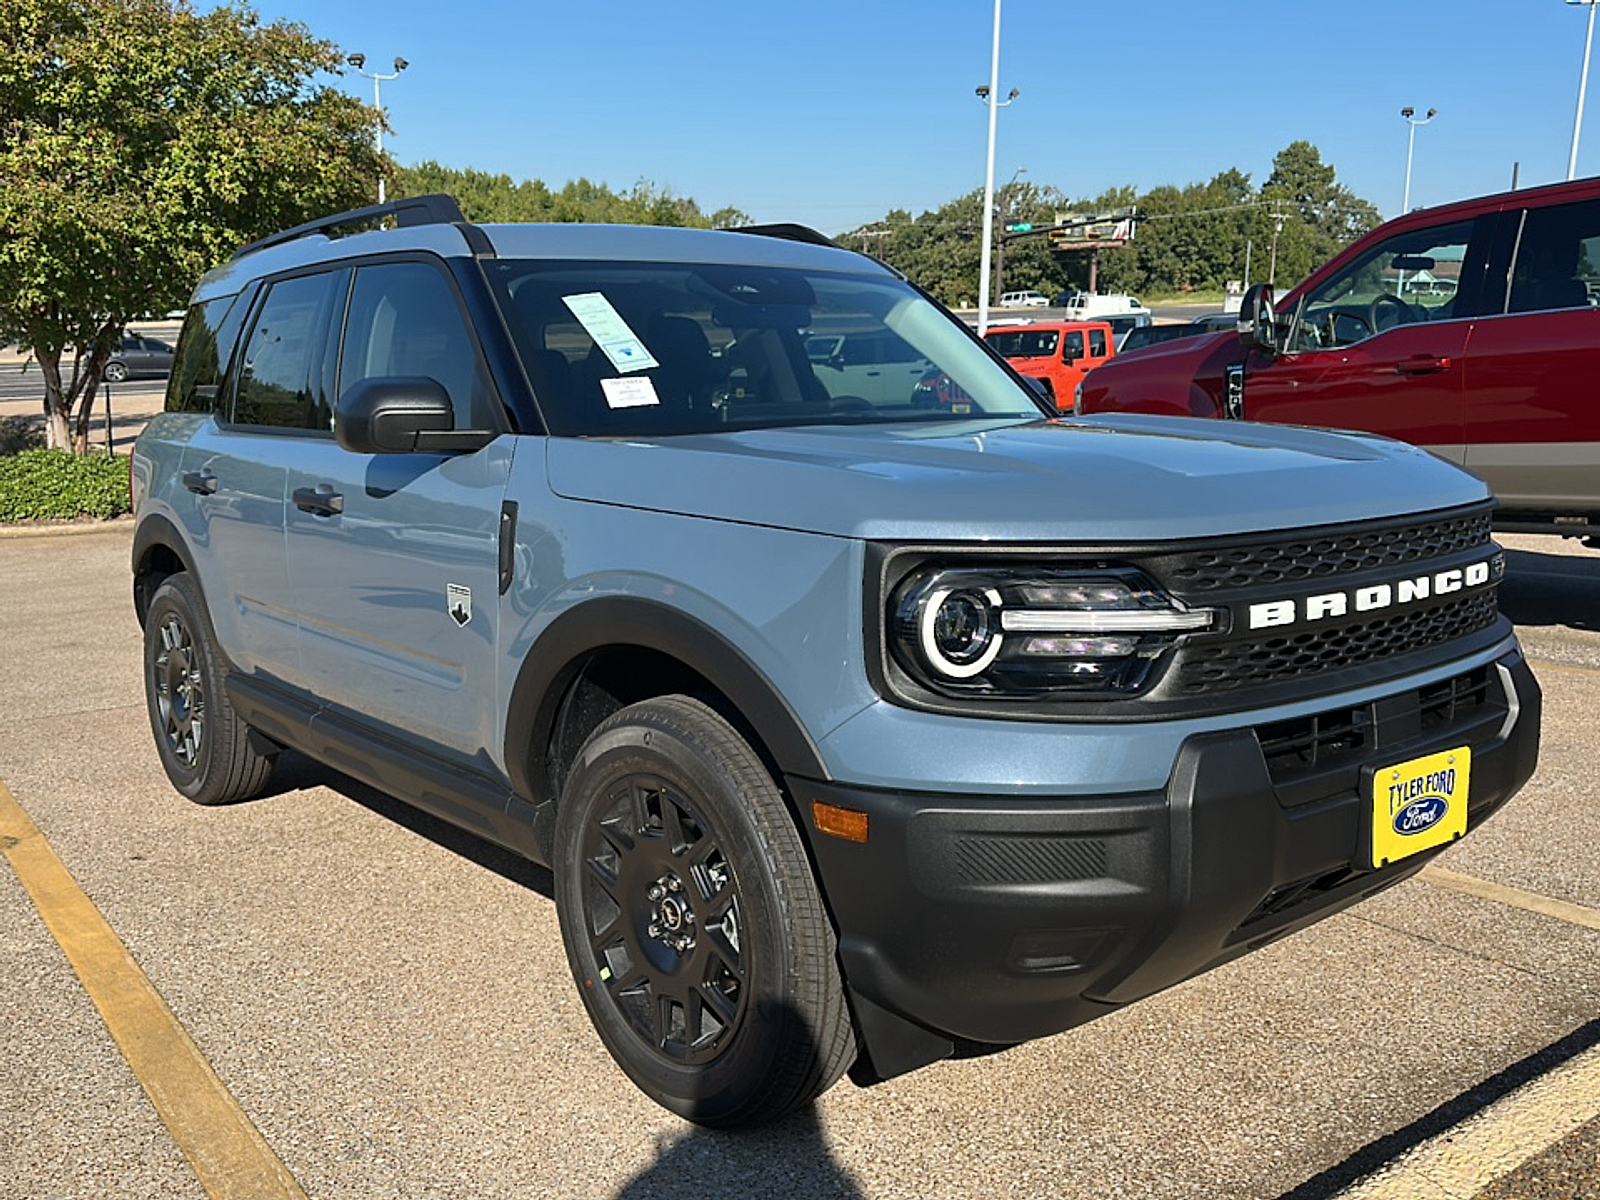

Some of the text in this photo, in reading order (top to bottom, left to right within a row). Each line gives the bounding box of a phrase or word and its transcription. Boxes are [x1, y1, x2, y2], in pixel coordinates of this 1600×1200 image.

[1250, 561, 1488, 629] BRONCO
[1389, 768, 1455, 817] TYLER FORD
[1403, 801, 1438, 829] Ford
